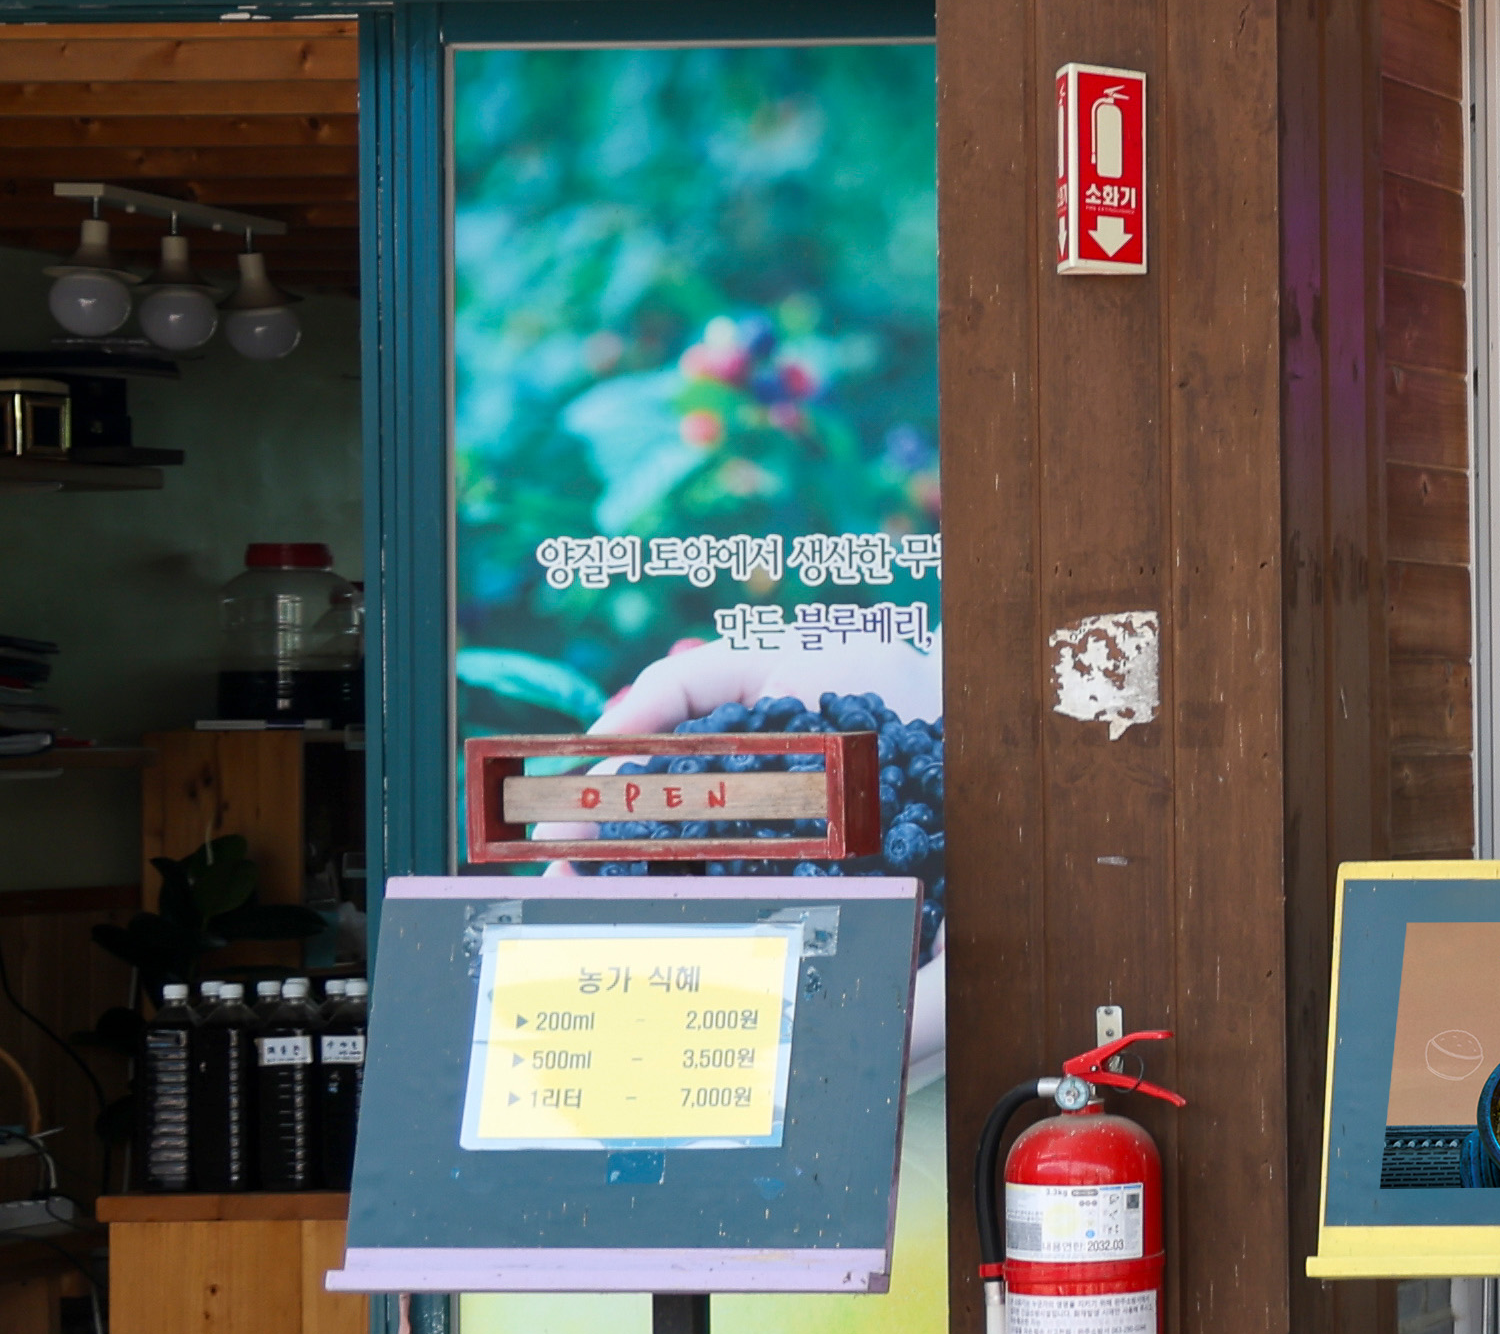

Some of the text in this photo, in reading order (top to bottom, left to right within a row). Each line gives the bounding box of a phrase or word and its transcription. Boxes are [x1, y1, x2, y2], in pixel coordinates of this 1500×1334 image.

[1085, 183, 1136, 209] 소화기
[537, 535, 640, 593] 양질의
[643, 533, 784, 586] 토양에서
[786, 533, 896, 587] 생산한
[715, 601, 932, 655] 만든 블루베리,
[579, 781, 728, 814] OPEN
[578, 964, 702, 995] 농가 식혜
[535, 1008, 761, 1034] 200ml 2,000원
[532, 1046, 757, 1072] 500ml 3,500원
[529, 1085, 753, 1112] 1리터 7,000원
[1087, 1238, 1124, 1253] 2032.03
